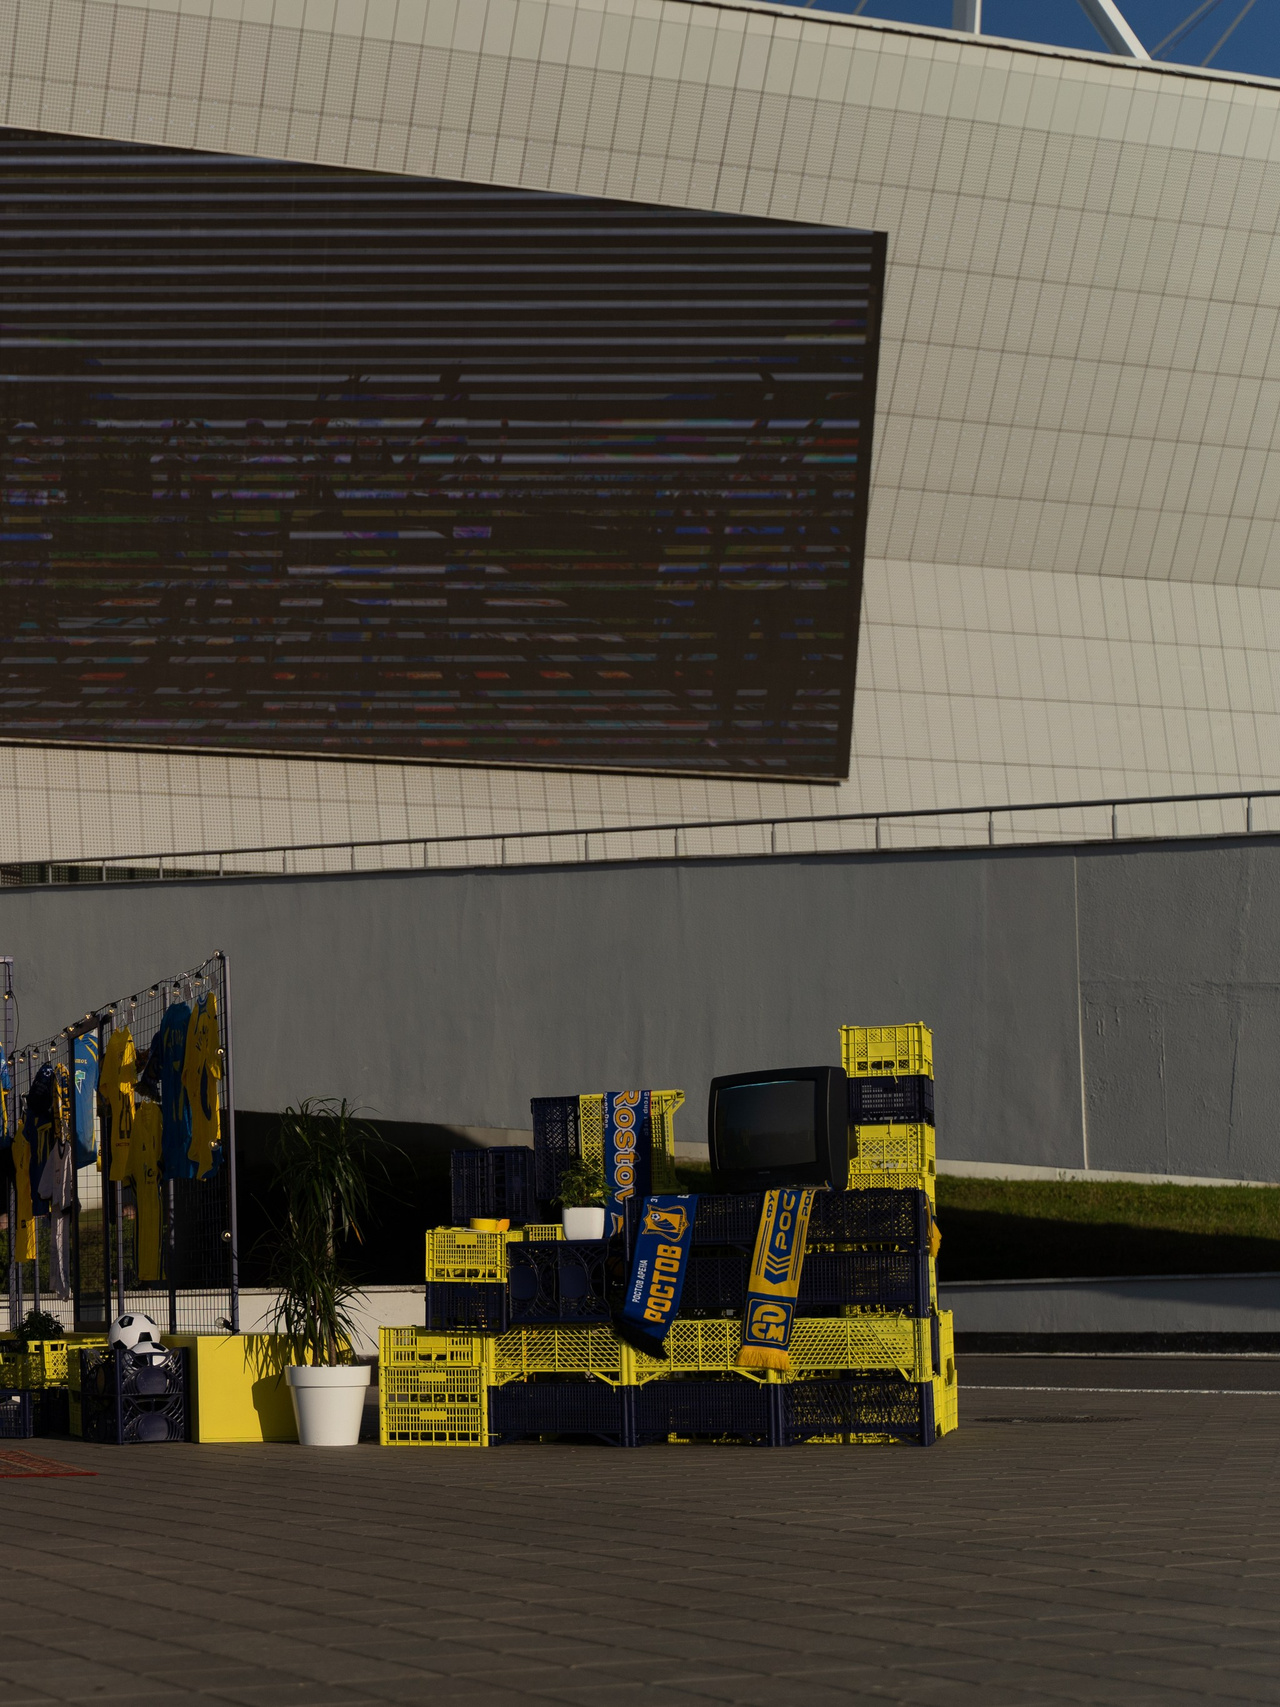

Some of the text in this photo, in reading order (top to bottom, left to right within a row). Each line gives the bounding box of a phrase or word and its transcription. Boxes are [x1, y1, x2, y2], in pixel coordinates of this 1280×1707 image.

[643, 1091, 651, 1114] Group
[631, 1259, 649, 1304] РОСТОВ АРЕНА
[642, 1243, 683, 1324] РОСТОВ
